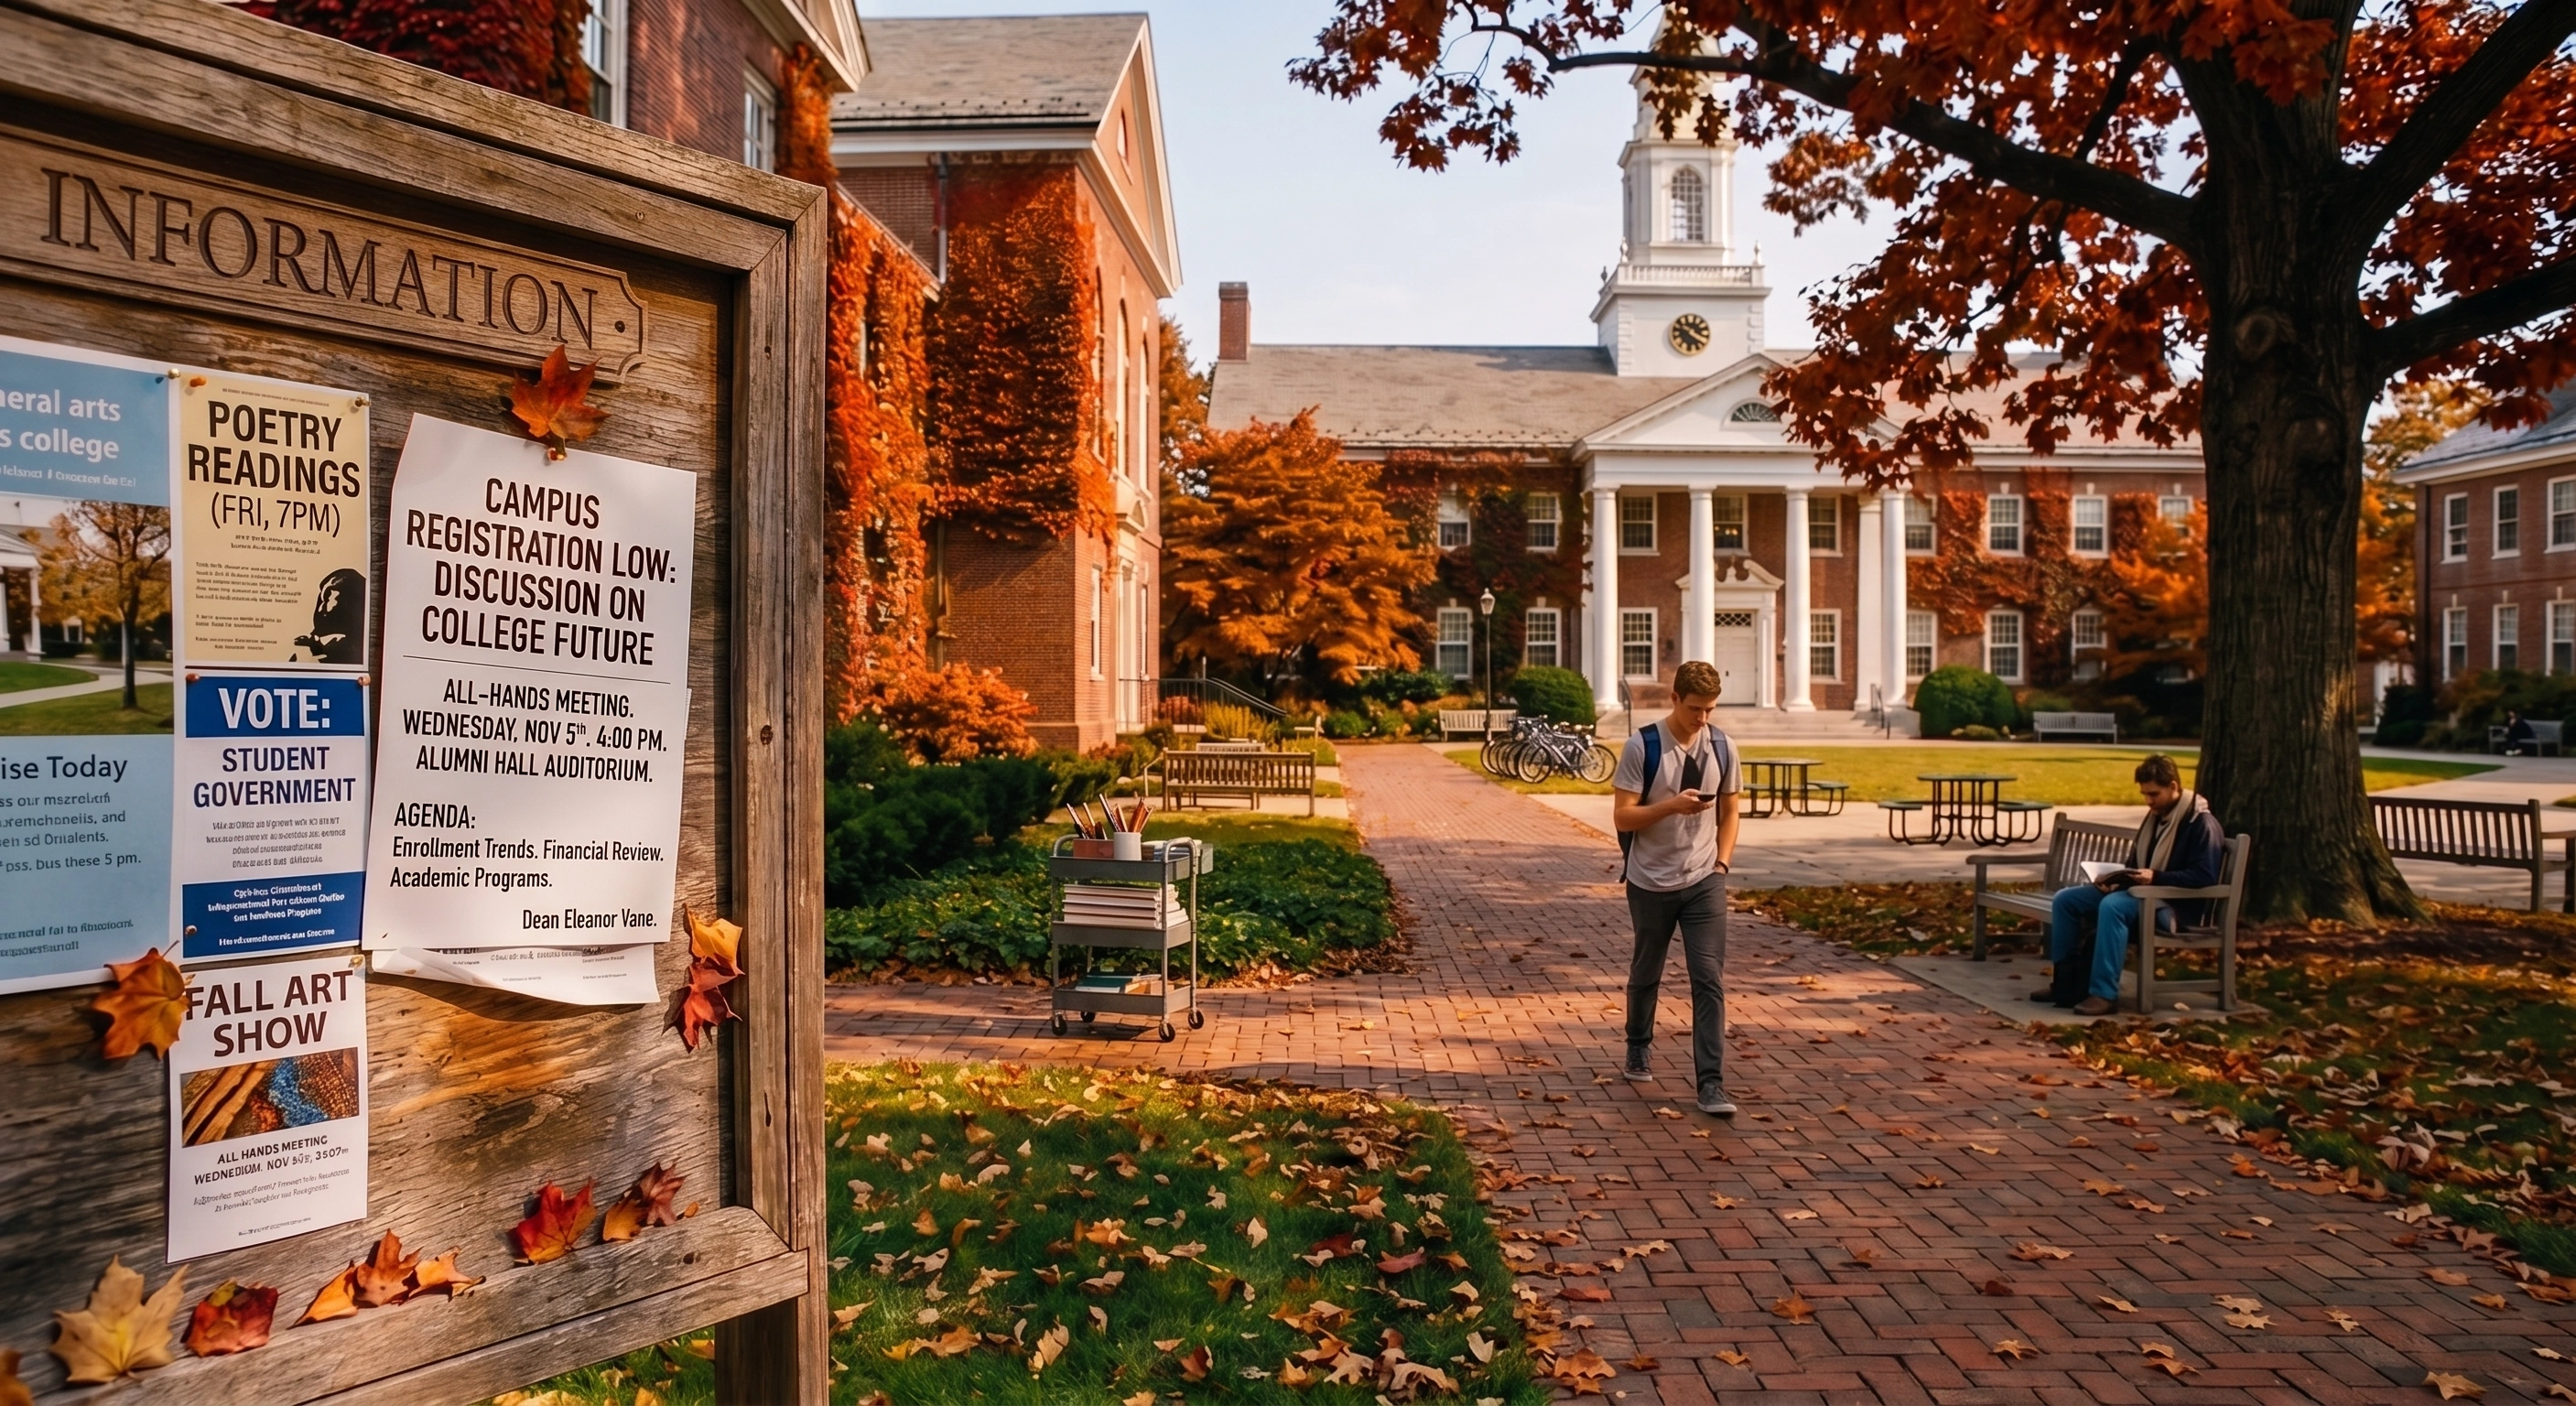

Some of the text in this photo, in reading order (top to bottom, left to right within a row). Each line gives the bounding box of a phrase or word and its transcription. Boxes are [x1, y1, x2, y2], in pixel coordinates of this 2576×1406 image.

[41, 168, 598, 350] INFORMATION
[69, 398, 121, 421] arts
[208, 400, 342, 452] POETRY
[19, 428, 119, 463] college
[188, 444, 360, 498] READINGS
[211, 492, 341, 537] (FRI, 7PM)
[485, 477, 601, 530] CAMPUS
[406, 509, 676, 584] REGISTRATION LOW:
[435, 559, 645, 622] DISCUSSION ON
[422, 604, 655, 665] COLLEGE FUTURE
[218, 687, 330, 729] VOTE:
[443, 678, 633, 718] ALL-HANDS MEETING.
[403, 708, 517, 742] WEDNESDAY,
[525, 719, 562, 744] NOV
[596, 725, 633, 750] 4:00
[637, 728, 667, 752] PM.
[48, 754, 128, 783] Today
[222, 746, 330, 773] STUDENT
[416, 745, 653, 783] ALUMNI HALL AUDITORIUM.
[193, 777, 356, 807] GOVERNMENT
[102, 810, 125, 823] and
[394, 803, 476, 829] AGENDA:
[65, 857, 100, 868] these
[104, 853, 113, 865] 5
[116, 854, 141, 868] pm.
[393, 837, 664, 862] Enrollment Trends. Financial Review.
[390, 867, 553, 892] Academic Programs.
[523, 909, 657, 930] Dean Eleanor Vane.
[186, 969, 353, 1021] FALL ART
[214, 1011, 327, 1057] SHOW
[217, 1152, 239, 1164] ALL
[242, 1143, 279, 1160] HANDS
[281, 1135, 328, 1152] MEETING
[267, 1156, 290, 1171] NOV
